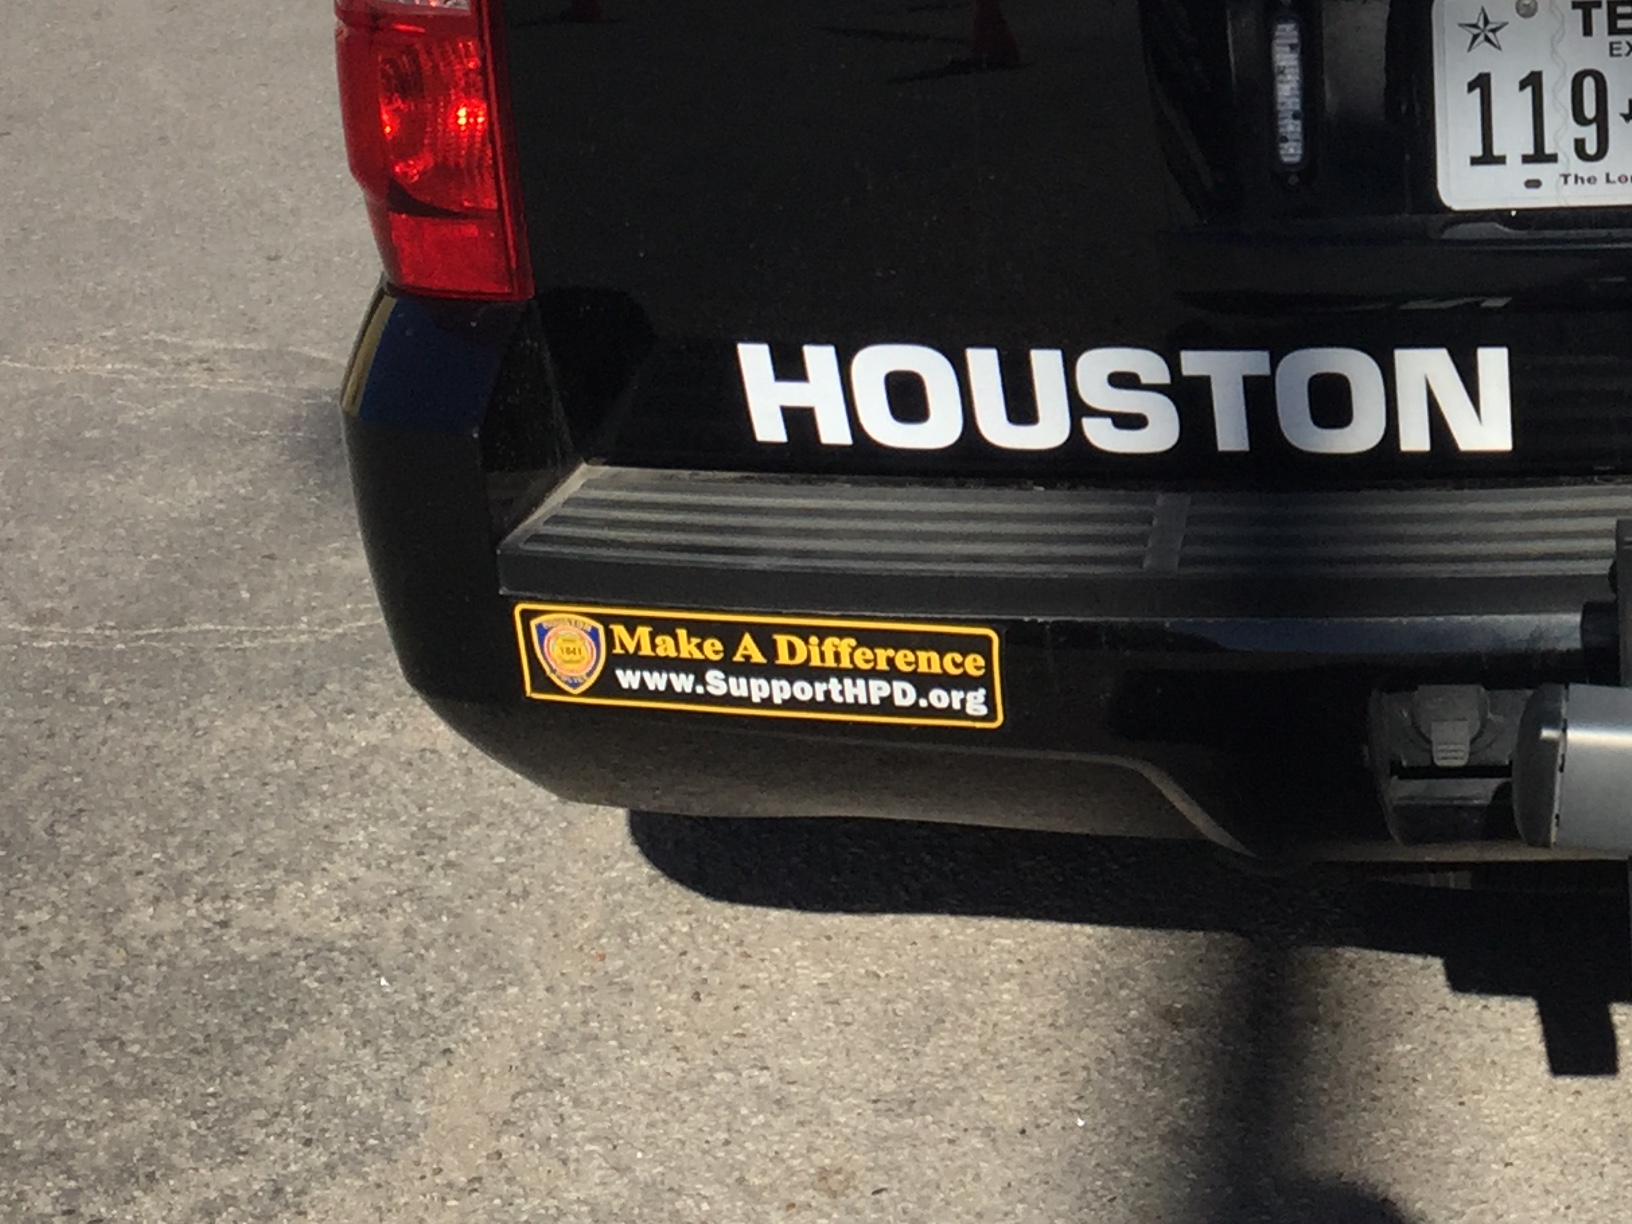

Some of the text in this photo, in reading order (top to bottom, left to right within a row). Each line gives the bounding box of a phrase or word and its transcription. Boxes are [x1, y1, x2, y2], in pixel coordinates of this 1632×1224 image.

[1466, 68, 1610, 167] 119
[1559, 172, 1598, 186] The
[735, 341, 1514, 455] HOUSTON
[609, 623, 987, 677] Make A Difference
[615, 666, 989, 716] www.SupportHPD.org
